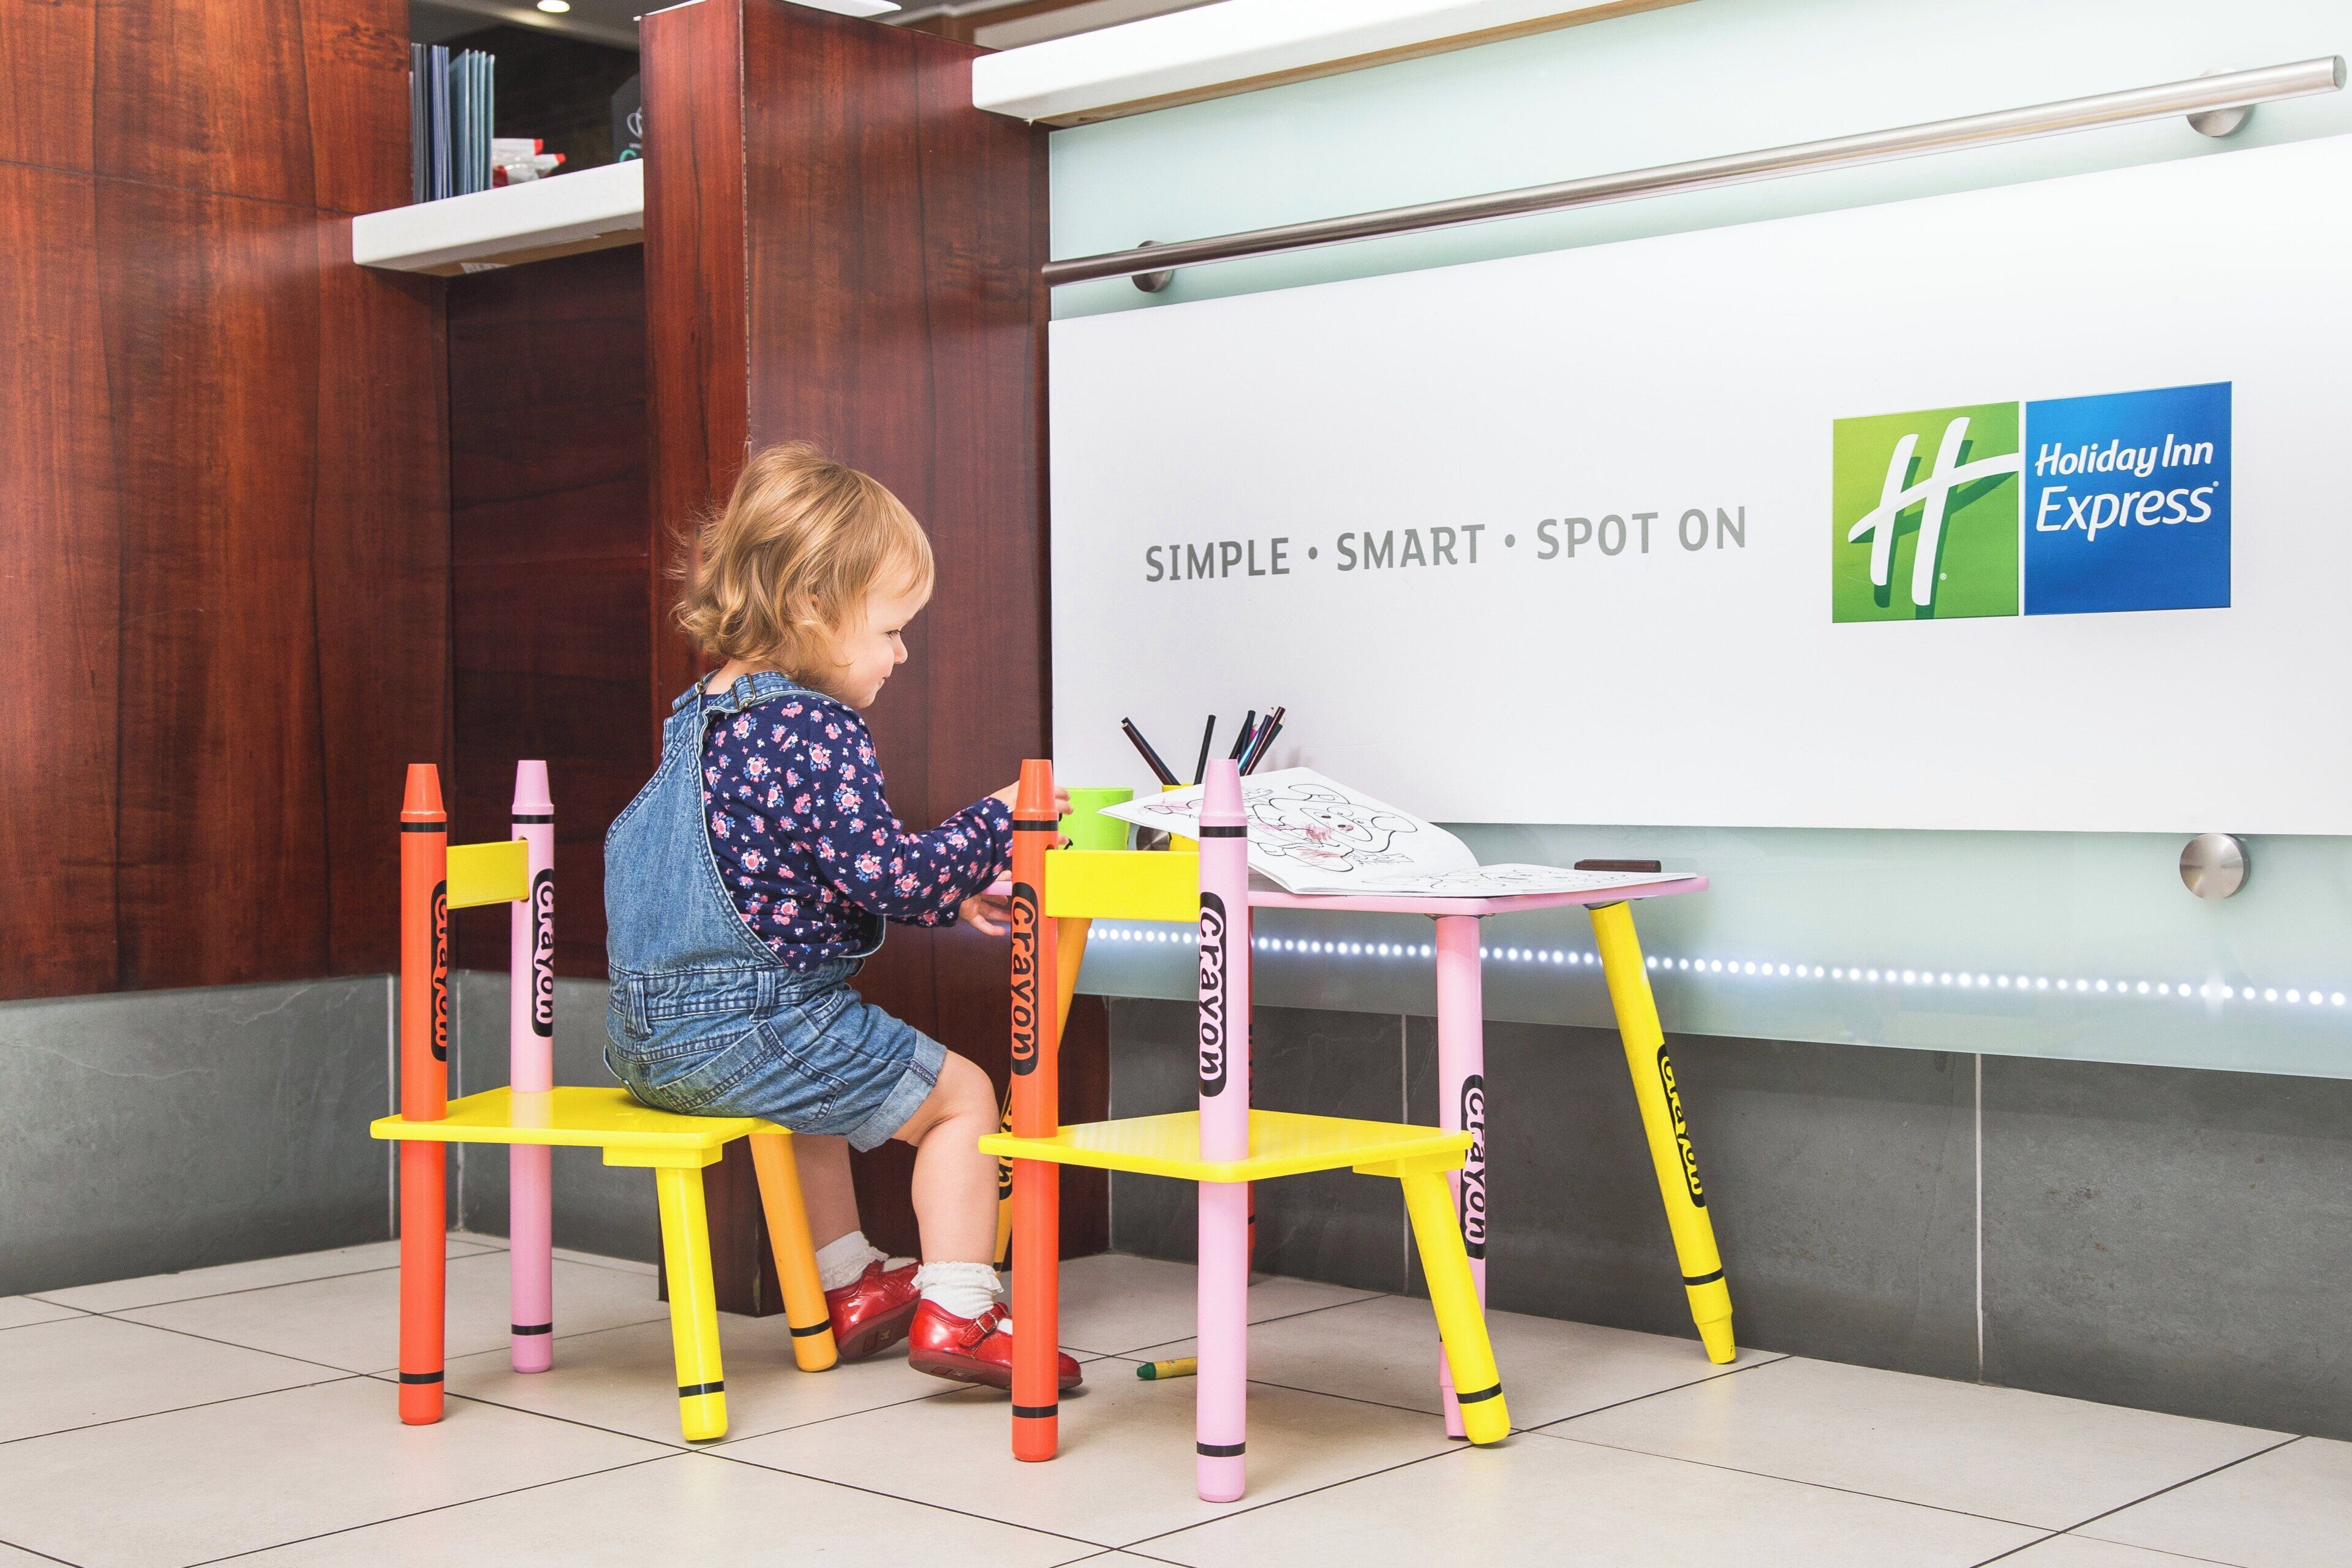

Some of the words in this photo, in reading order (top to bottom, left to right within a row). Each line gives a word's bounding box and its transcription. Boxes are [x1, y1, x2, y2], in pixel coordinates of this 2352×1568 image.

[2035, 439, 2157, 477] Holiday
[2162, 434, 2214, 467] Inn
[2036, 486, 2214, 541] Express
[1145, 537, 1291, 582] SIMPLE
[1336, 524, 1485, 571] SMART
[1536, 512, 1659, 560] SPOT
[1678, 506, 1746, 551] ON
[1012, 895, 1036, 1060] Crayon
[1199, 907, 1224, 1080] Crayon
[1463, 1087, 1485, 1244] Crayon
